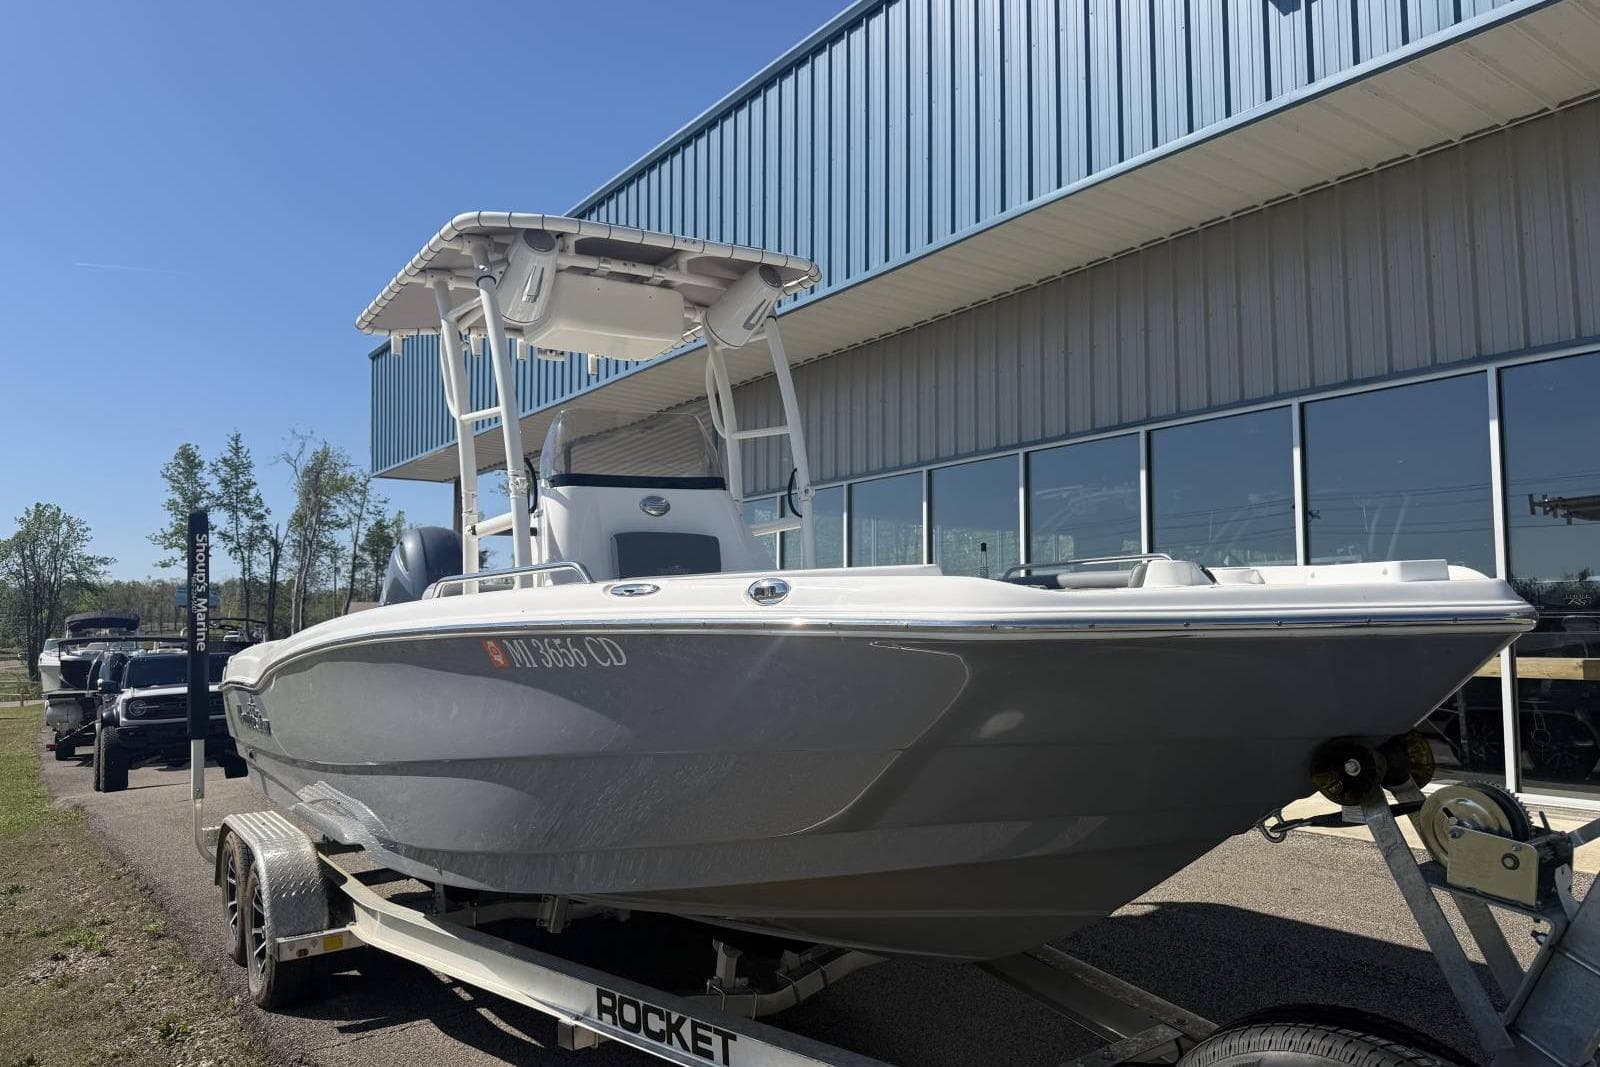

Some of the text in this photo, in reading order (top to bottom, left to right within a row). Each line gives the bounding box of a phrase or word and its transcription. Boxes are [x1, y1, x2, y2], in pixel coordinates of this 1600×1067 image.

[196, 534, 208, 651] Shoup's Marine
[503, 639, 537, 668] MI
[533, 637, 588, 668] 3656
[584, 636, 627, 667] CD
[597, 988, 737, 1066] ROCKET
